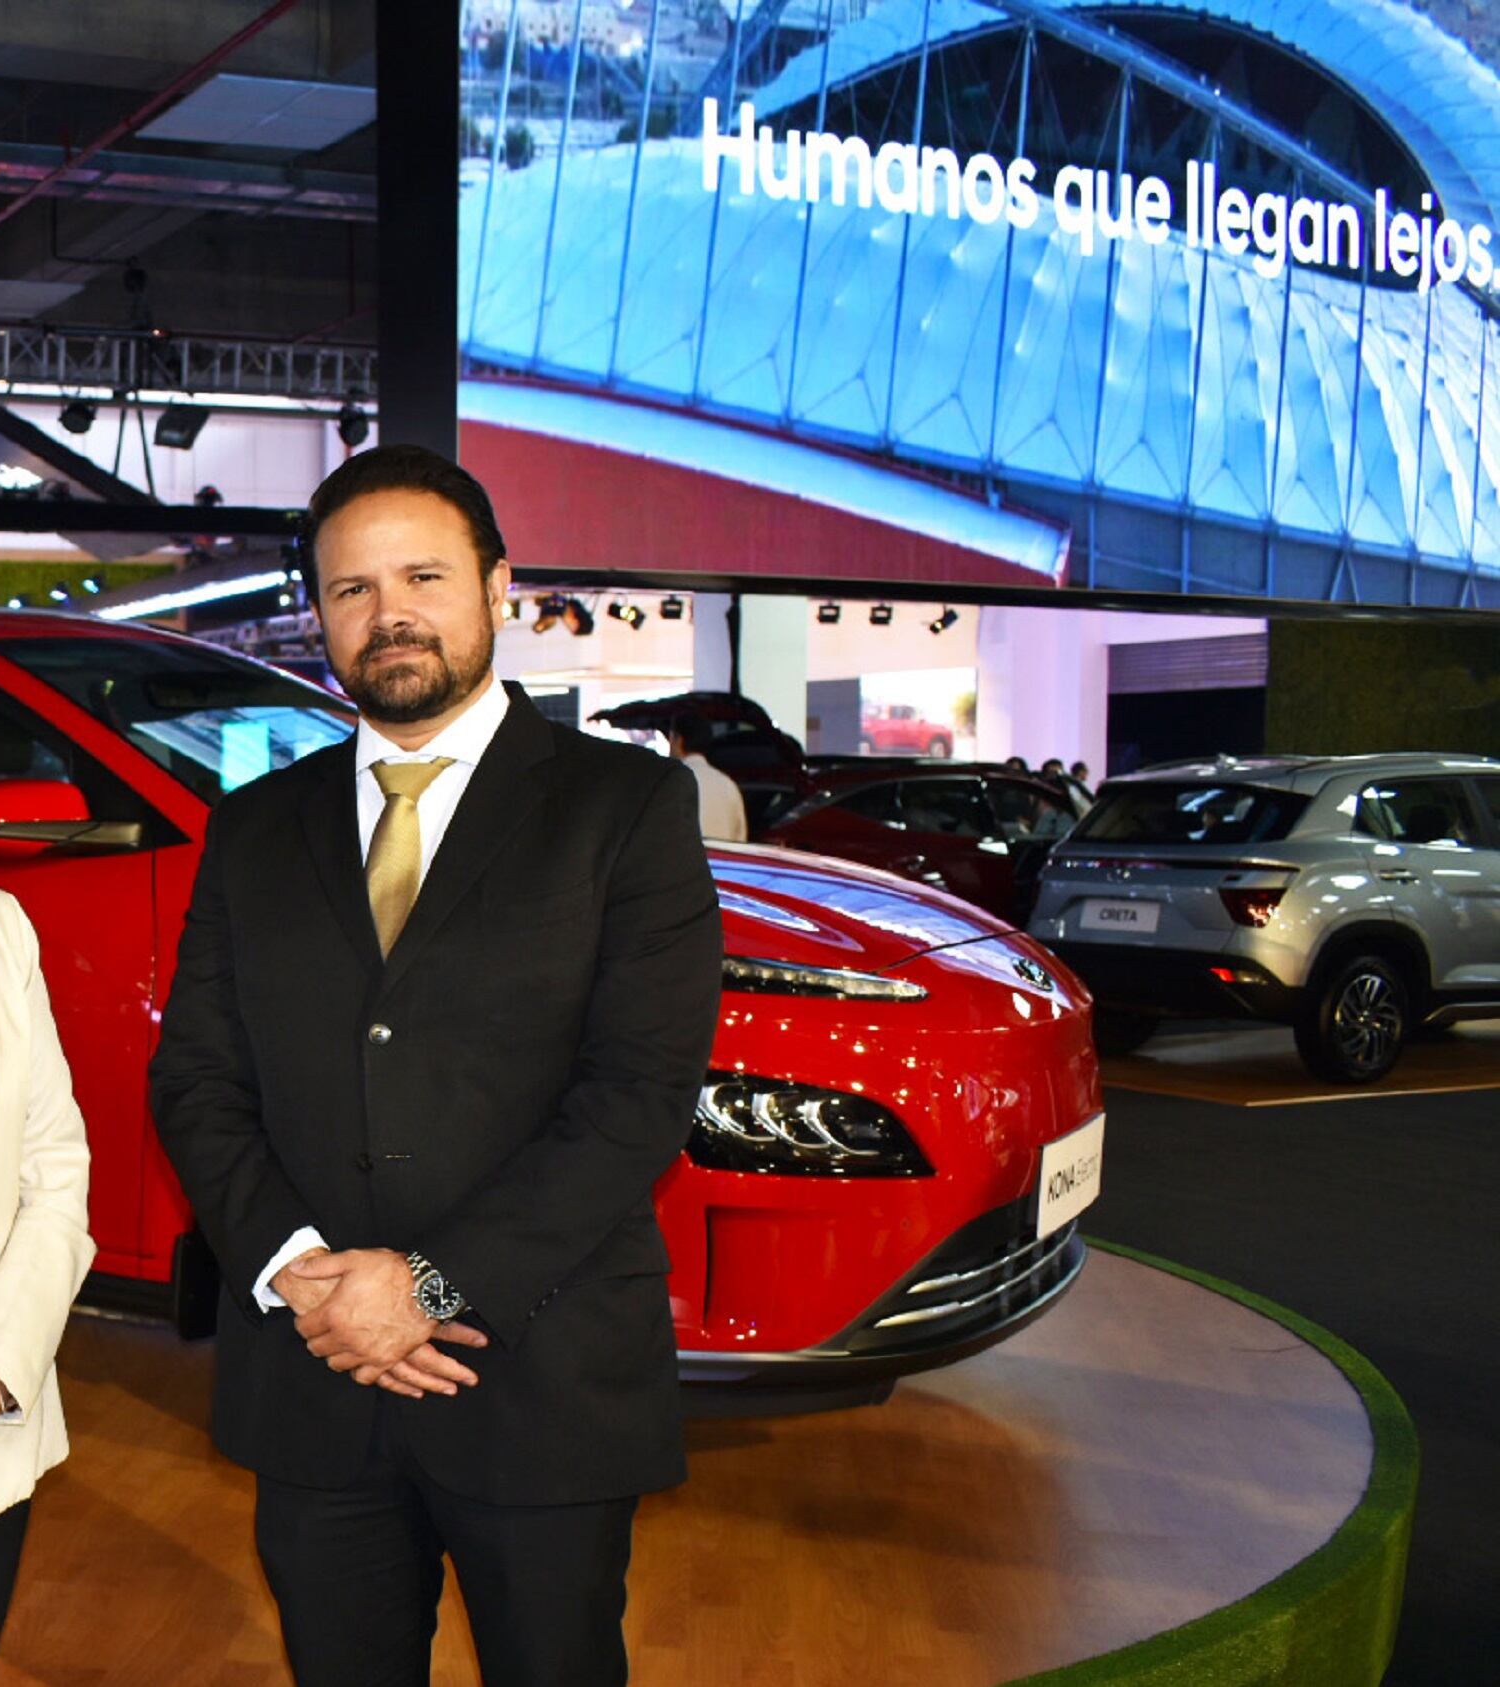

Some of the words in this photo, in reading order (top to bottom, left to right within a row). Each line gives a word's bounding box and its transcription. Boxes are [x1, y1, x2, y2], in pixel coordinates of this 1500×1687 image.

[703, 97, 1039, 229] Humanos
[1054, 164, 1171, 256] que
[1187, 159, 1360, 279] llegan
